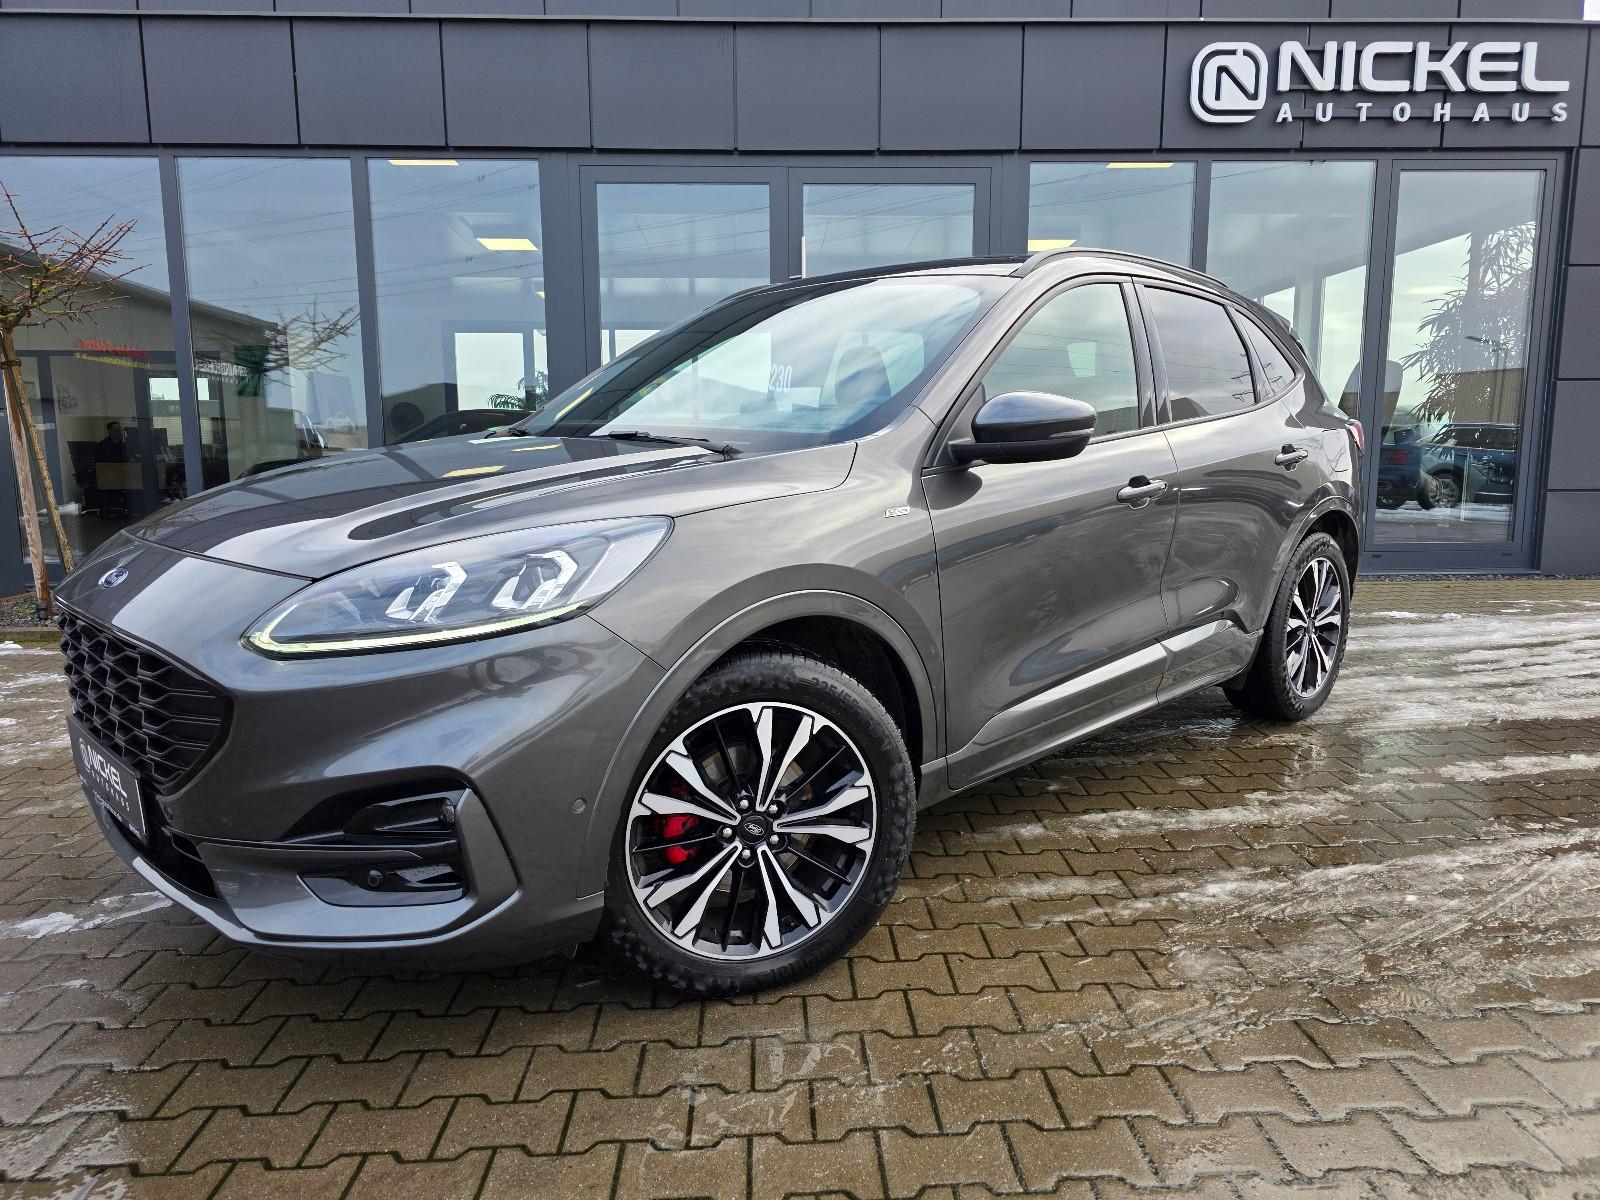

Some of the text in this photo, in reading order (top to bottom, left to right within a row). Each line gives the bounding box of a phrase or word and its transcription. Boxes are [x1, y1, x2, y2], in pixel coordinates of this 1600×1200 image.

[1277, 41, 1570, 92] NICKEL
[1276, 102, 1568, 123] AUTOHAUS
[87, 744, 128, 798] NICKEL
